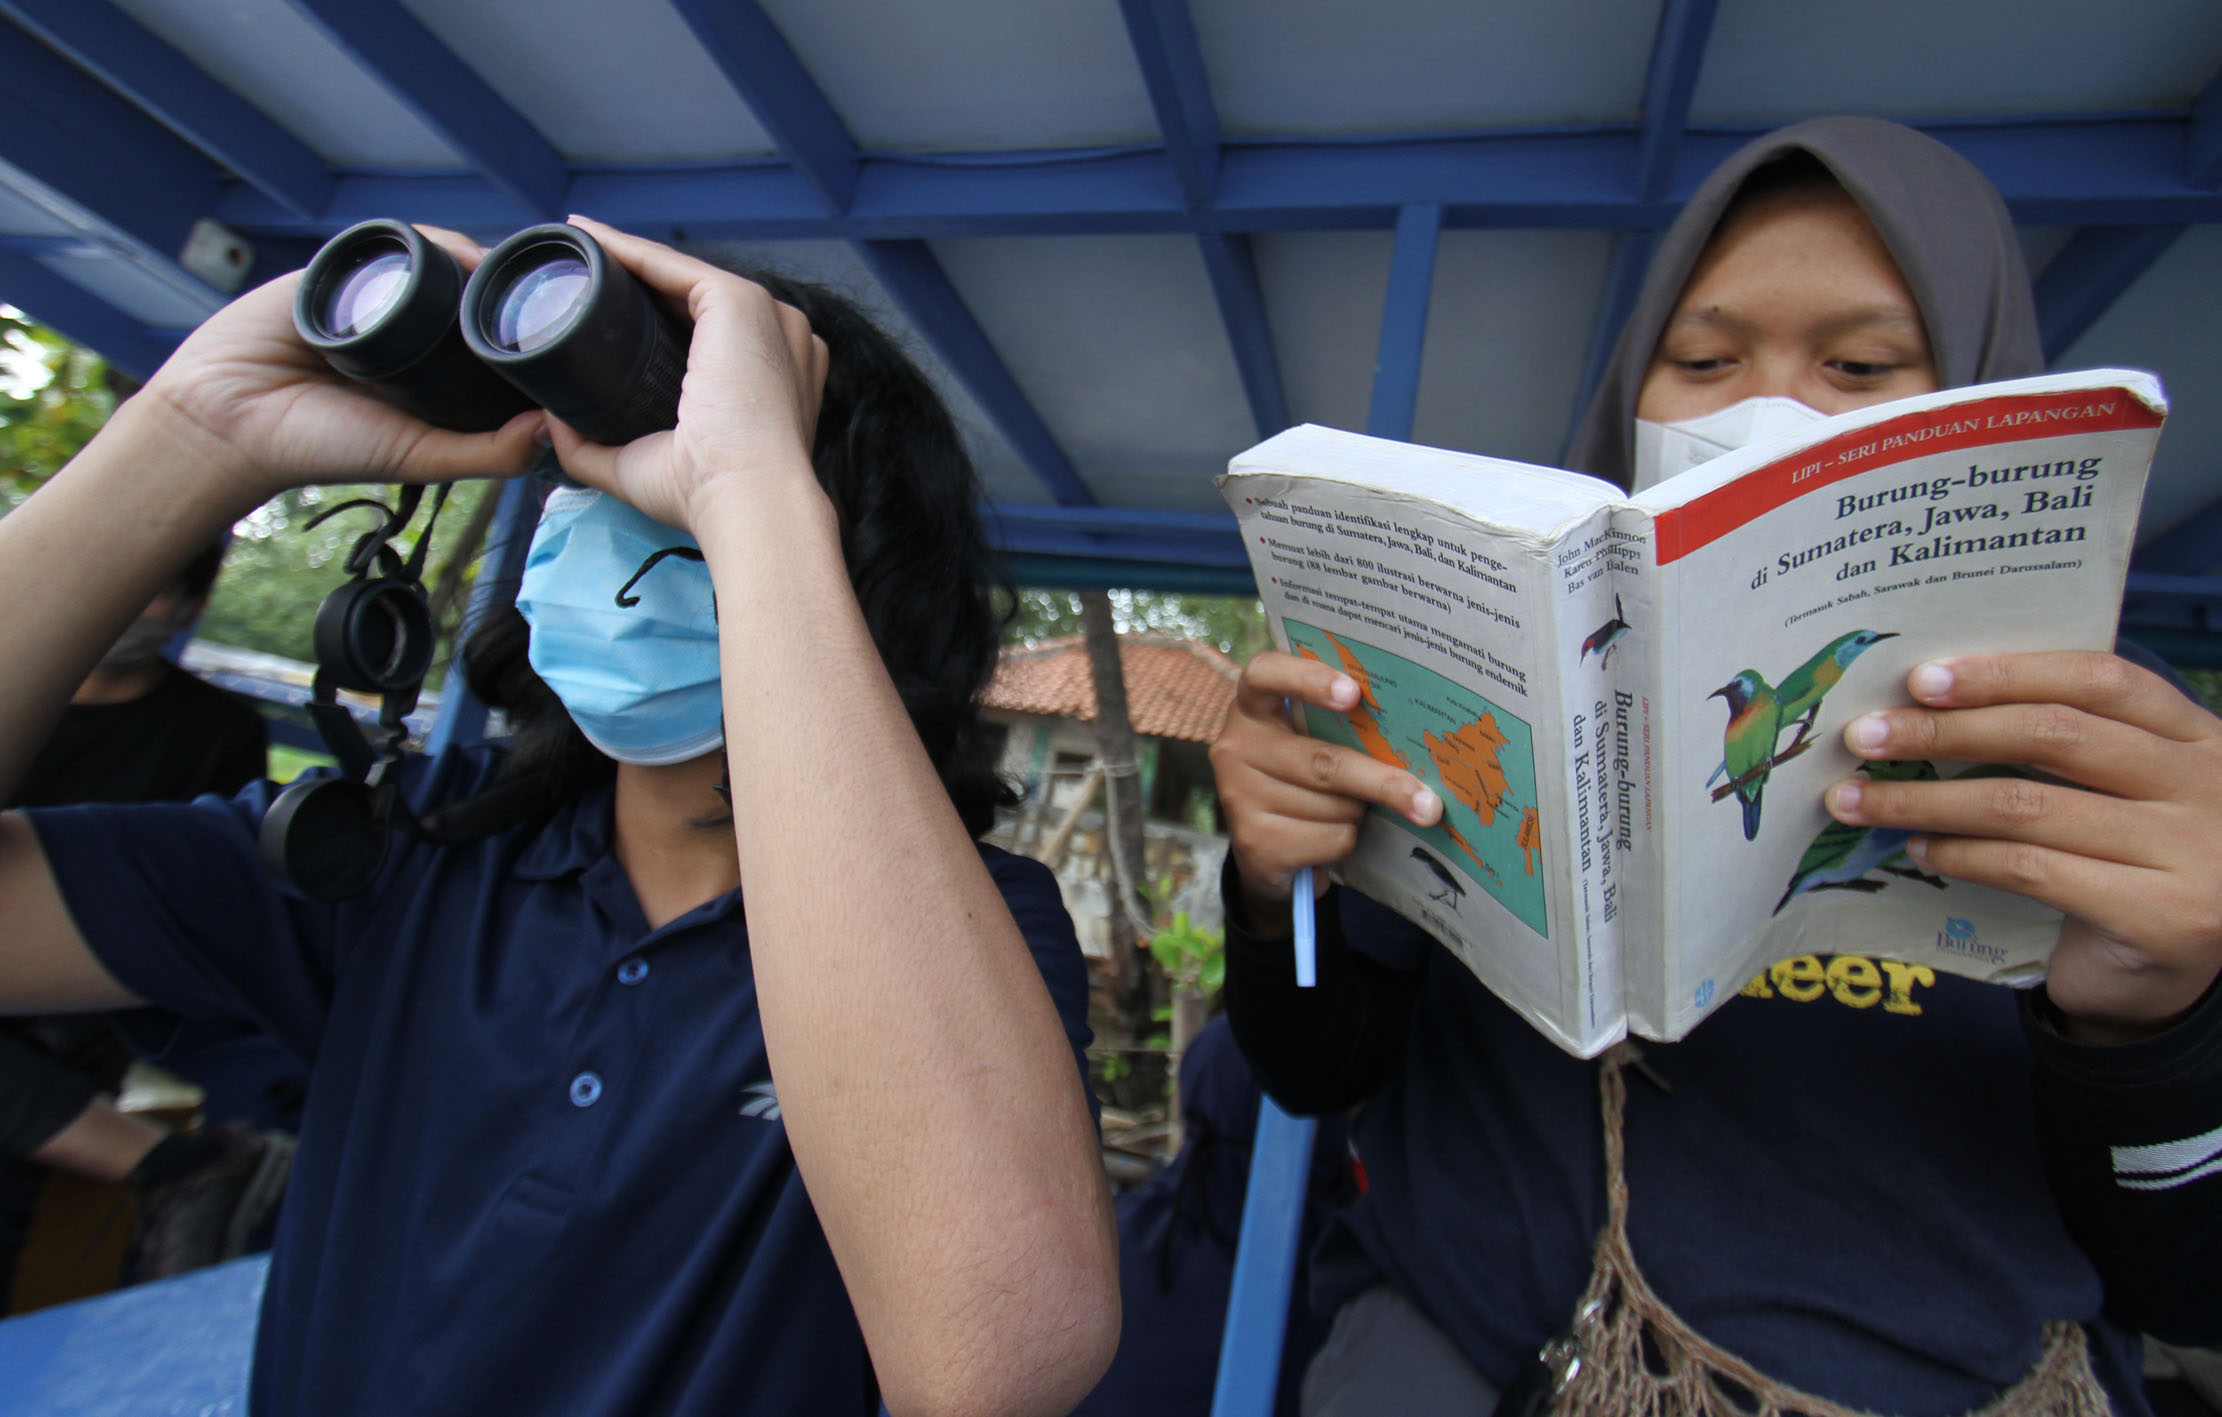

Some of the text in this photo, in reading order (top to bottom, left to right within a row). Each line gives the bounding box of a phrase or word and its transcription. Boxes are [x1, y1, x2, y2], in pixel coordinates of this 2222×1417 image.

[1792, 462, 1822, 485] LIPI
[1838, 441, 1877, 465] SERI
[1882, 417, 1980, 452] PANDUAN
[1985, 402, 2117, 429] LAPANGAN
[1835, 457, 2103, 520] Burung-burung
[1255, 498, 1508, 571] Sebuah panduan identifikasi lengkap untuk penge-
[1260, 511, 1518, 593] tahuan burung di Sumatera, Jawa, Bali, dan Kalimantan
[1558, 527, 1646, 568] John MacKinnon
[1564, 559, 1592, 579] Karen
[1751, 484, 2095, 590] di Sumatera, Jawa, Bali
[1836, 525, 2087, 582] dan Kalimantan
[1268, 538, 1520, 629] Memuat lebih dari 800 ilustrasi berwarna jenis-jenis
[1271, 551, 1305, 569] burung
[1323, 564, 1358, 580] lembar
[1361, 575, 1398, 592] gambar
[1401, 585, 1452, 615] berwarna)
[1568, 559, 1639, 594] Bas van Balen
[1783, 558, 2084, 628] (Termasuk Sabah, Sarawak dan Brunei Darussalam)
[1279, 578, 1527, 683] Informasi tempat-tempat utama mengamati burung
[1284, 591, 1300, 603] dan
[1311, 600, 1335, 613] mana
[1337, 606, 1361, 620] dapat
[1364, 616, 1401, 634] mencari
[1403, 627, 1447, 655] jenis-jenis
[1449, 647, 1484, 675] burung
[1485, 670, 1528, 697] endemik
[1573, 714, 1586, 749] dan
[1613, 689, 1636, 852] Burung-burung
[1575, 750, 1592, 873] Kalimantan
[1595, 700, 1618, 924] di Sumatera, Jawa, Bali
